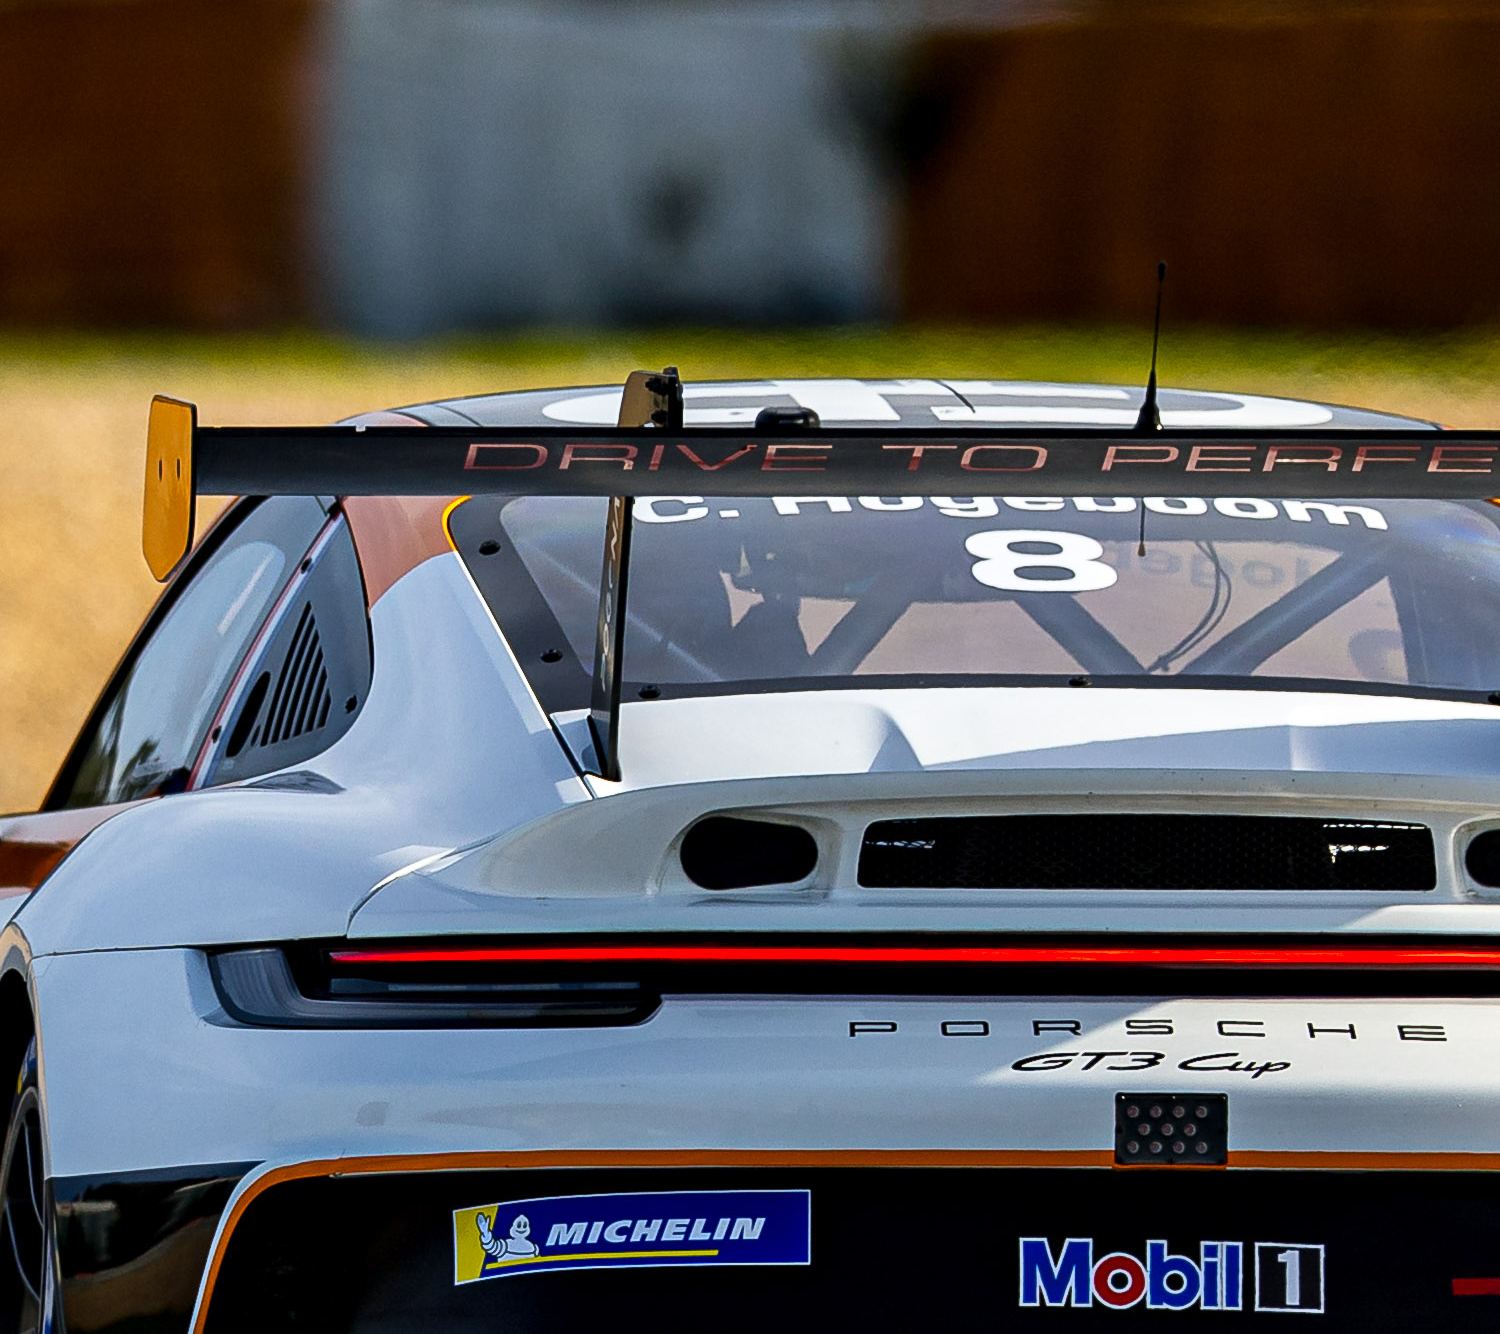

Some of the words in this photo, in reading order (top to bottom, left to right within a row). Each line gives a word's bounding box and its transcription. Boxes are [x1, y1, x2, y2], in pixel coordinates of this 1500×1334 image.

[463, 443, 834, 472] DRIVE
[881, 444, 1049, 472] TO
[630, 495, 740, 525] C.
[964, 528, 1119, 593] 8
[847, 1018, 1449, 1042] PORSCHE
[1010, 1051, 1166, 1073] GT3
[1176, 1051, 1292, 1080] Cup
[544, 1217, 767, 1247] MICHELIN
[1018, 1236, 1244, 1312] Mobil
